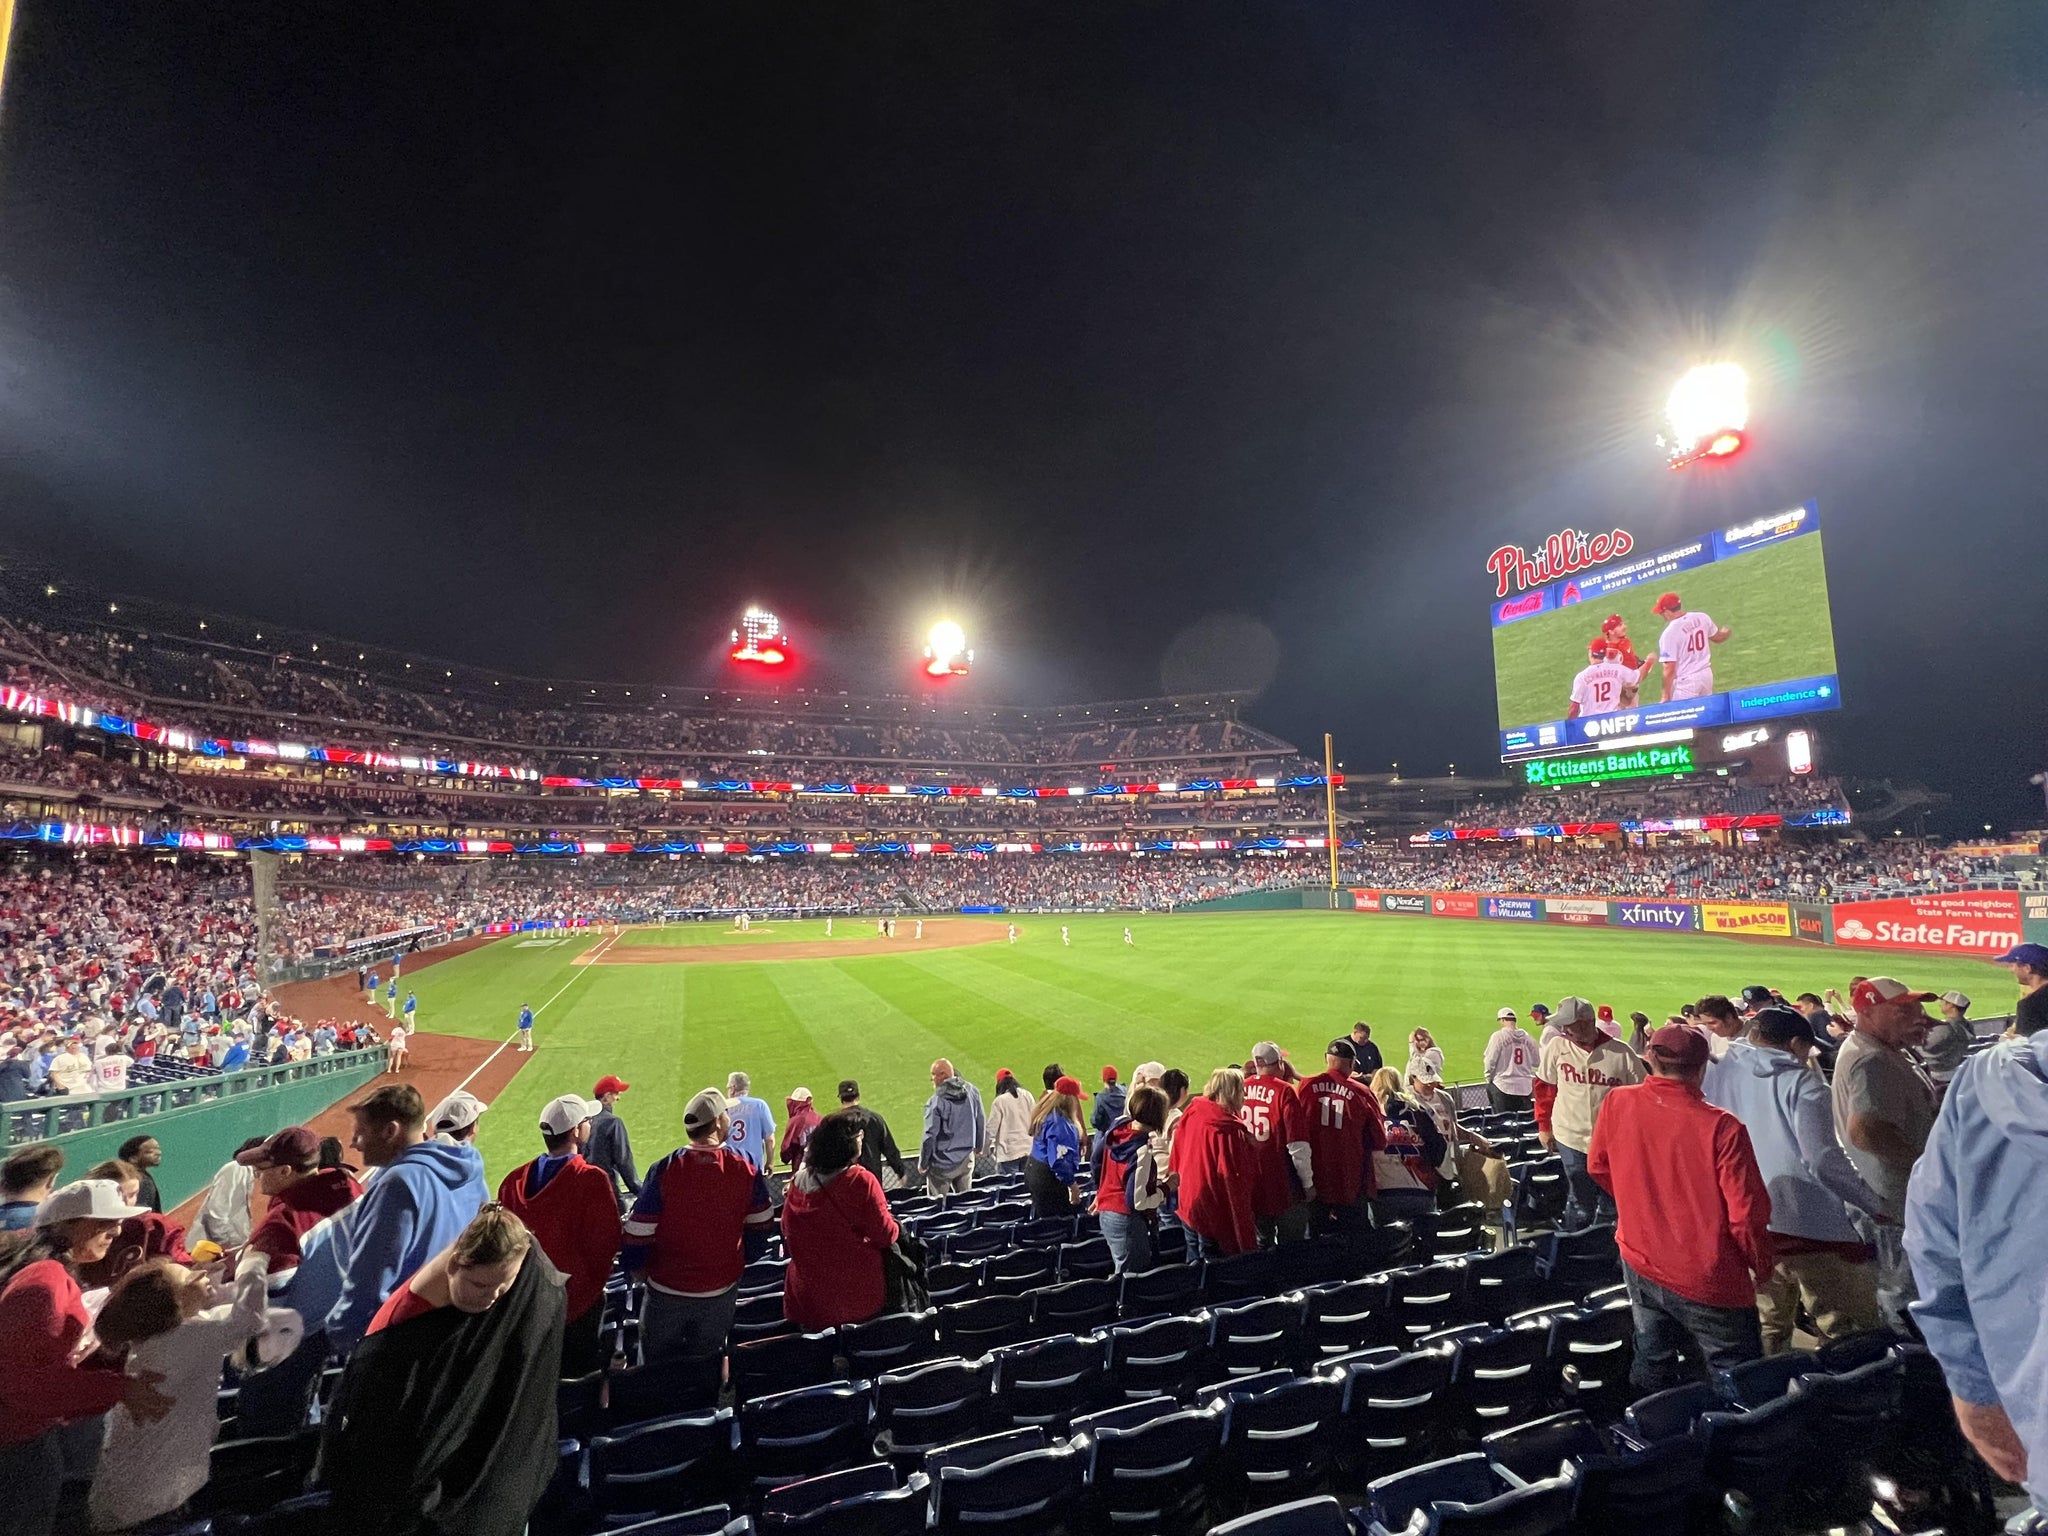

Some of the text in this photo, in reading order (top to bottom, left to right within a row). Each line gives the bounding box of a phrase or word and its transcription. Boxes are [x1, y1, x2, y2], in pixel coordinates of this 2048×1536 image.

[1487, 528, 1634, 597] Phillies
[1580, 575, 1602, 589] SALTZ
[1602, 562, 1678, 591] INJURY LAWYERS
[1687, 630, 1706, 654] 40
[1594, 681, 1611, 703] 12
[1740, 689, 1816, 708] Independence
[1601, 715, 1638, 735] NFP
[1547, 745, 1690, 778] Citizens Bank Park
[281, 783, 310, 794] HOME
[1397, 896, 1424, 907] NovaCare
[1498, 899, 1531, 909] SHERWIN
[1941, 900, 1965, 908] good
[1563, 913, 1589, 922] LAGER
[1621, 903, 1685, 926] xfinity
[1917, 908, 1943, 917] State
[1946, 909, 1972, 917] Farm
[1514, 1048, 1524, 1065] 8
[103, 1066, 121, 1078] 55
[1312, 1081, 1355, 1101] ROLLINS
[1318, 1096, 1345, 1130] 11
[732, 1119, 746, 1142] 3
